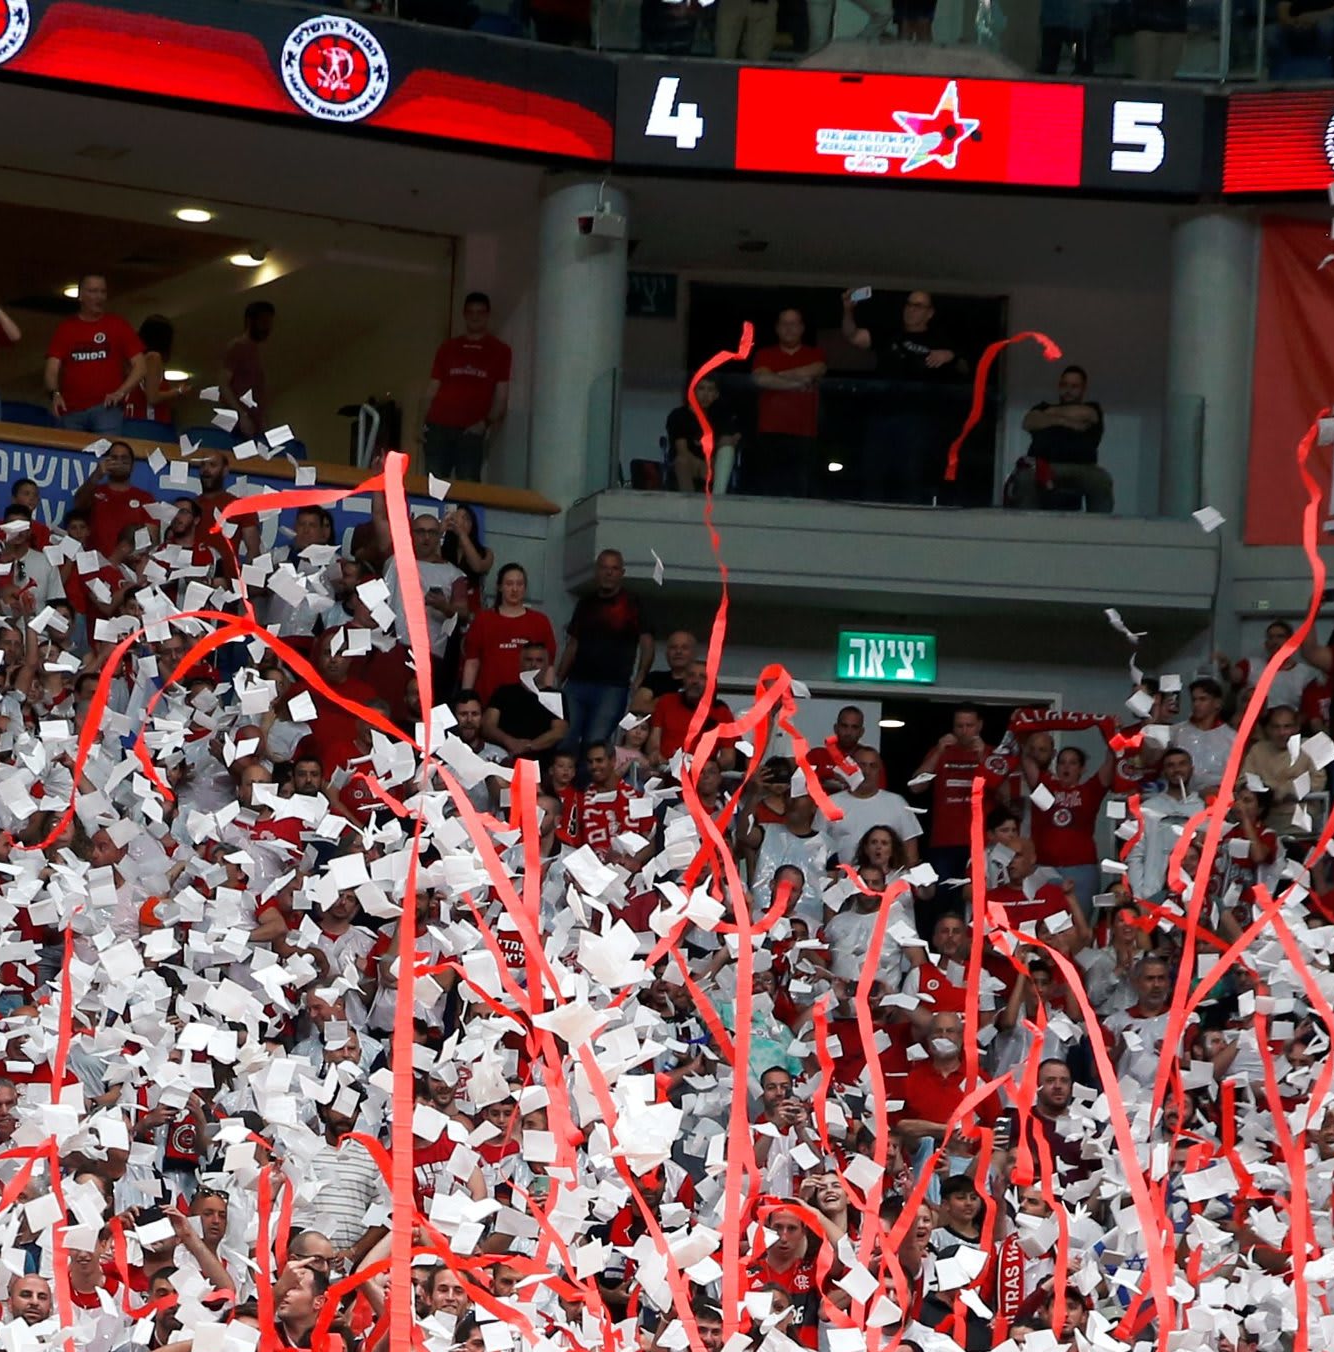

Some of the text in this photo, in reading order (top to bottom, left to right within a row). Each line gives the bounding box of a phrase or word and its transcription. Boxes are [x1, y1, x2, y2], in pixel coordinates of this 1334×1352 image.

[645, 77, 704, 149] 4
[1111, 101, 1164, 173] 5
[847, 638, 926, 679] יציאה
